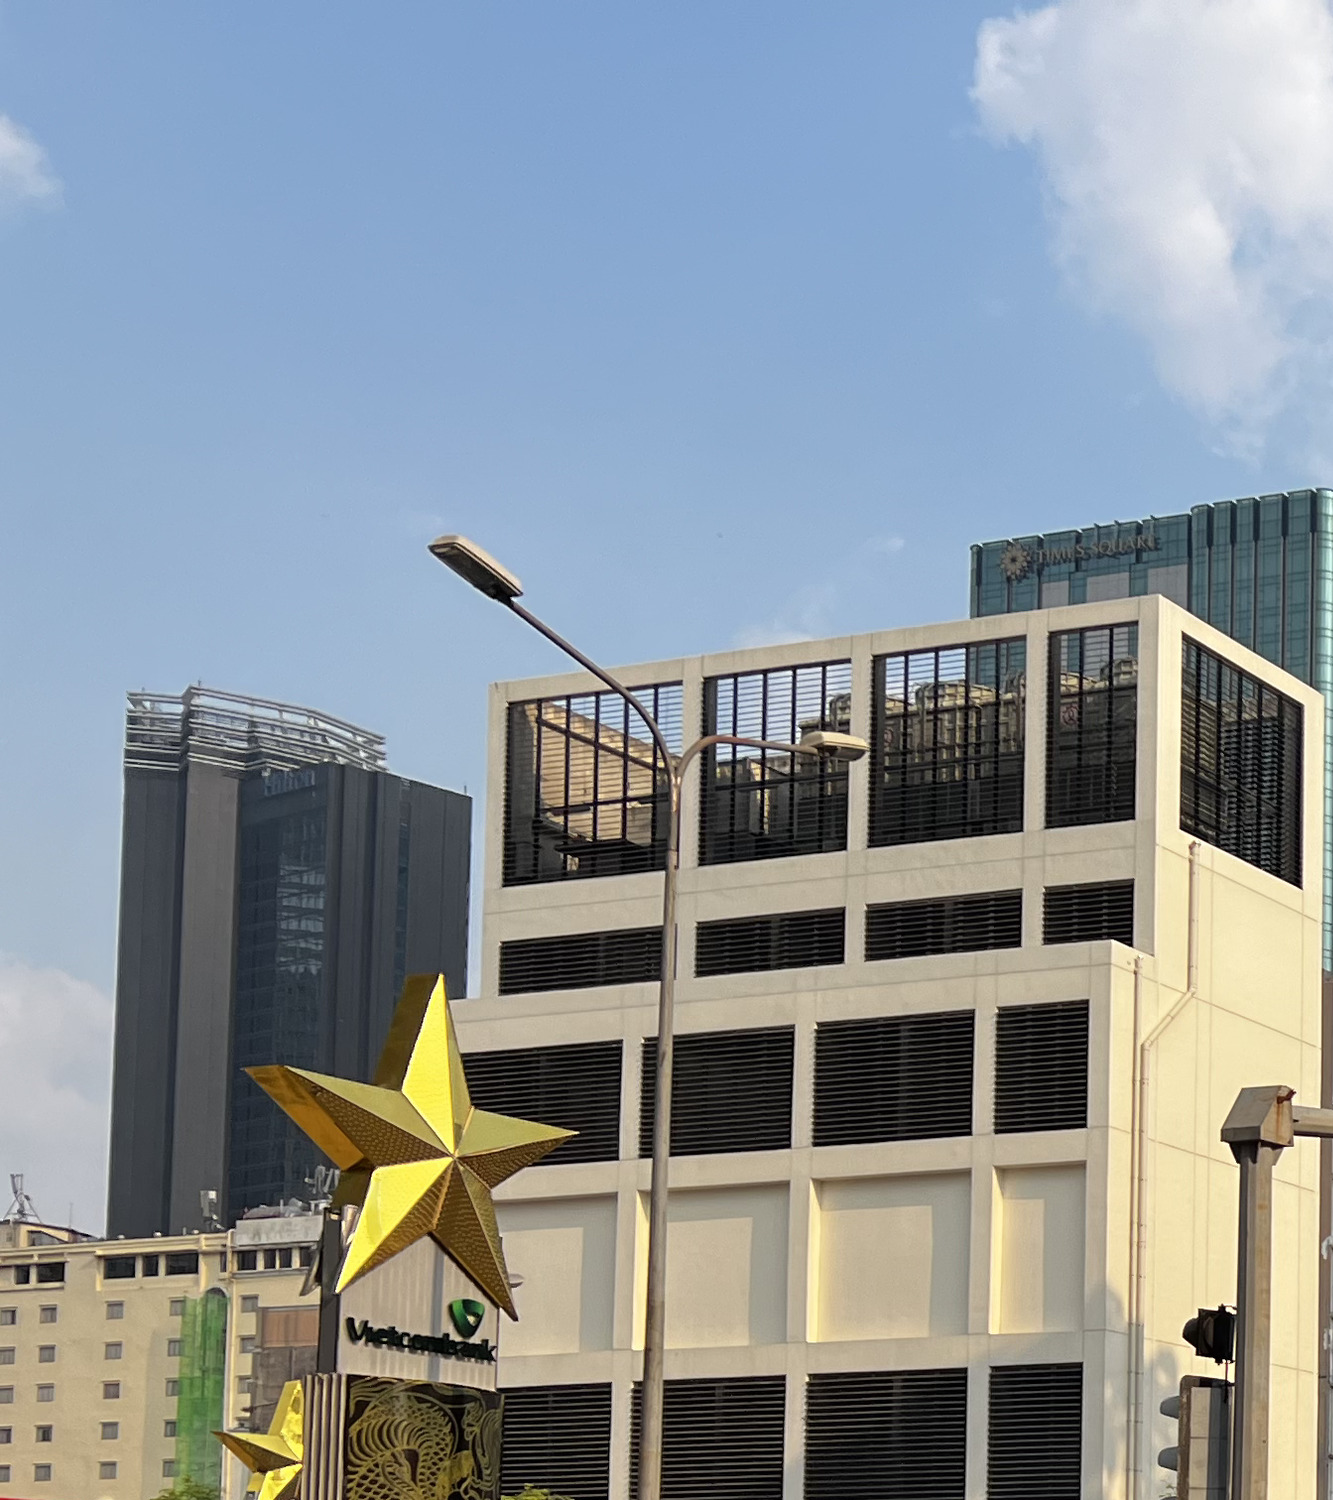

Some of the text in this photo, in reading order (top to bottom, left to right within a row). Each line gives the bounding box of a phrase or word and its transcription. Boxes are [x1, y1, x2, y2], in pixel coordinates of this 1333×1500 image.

[1036, 533, 1157, 564] TIMES SQUARE
[345, 1316, 498, 1362] Vietcombank
